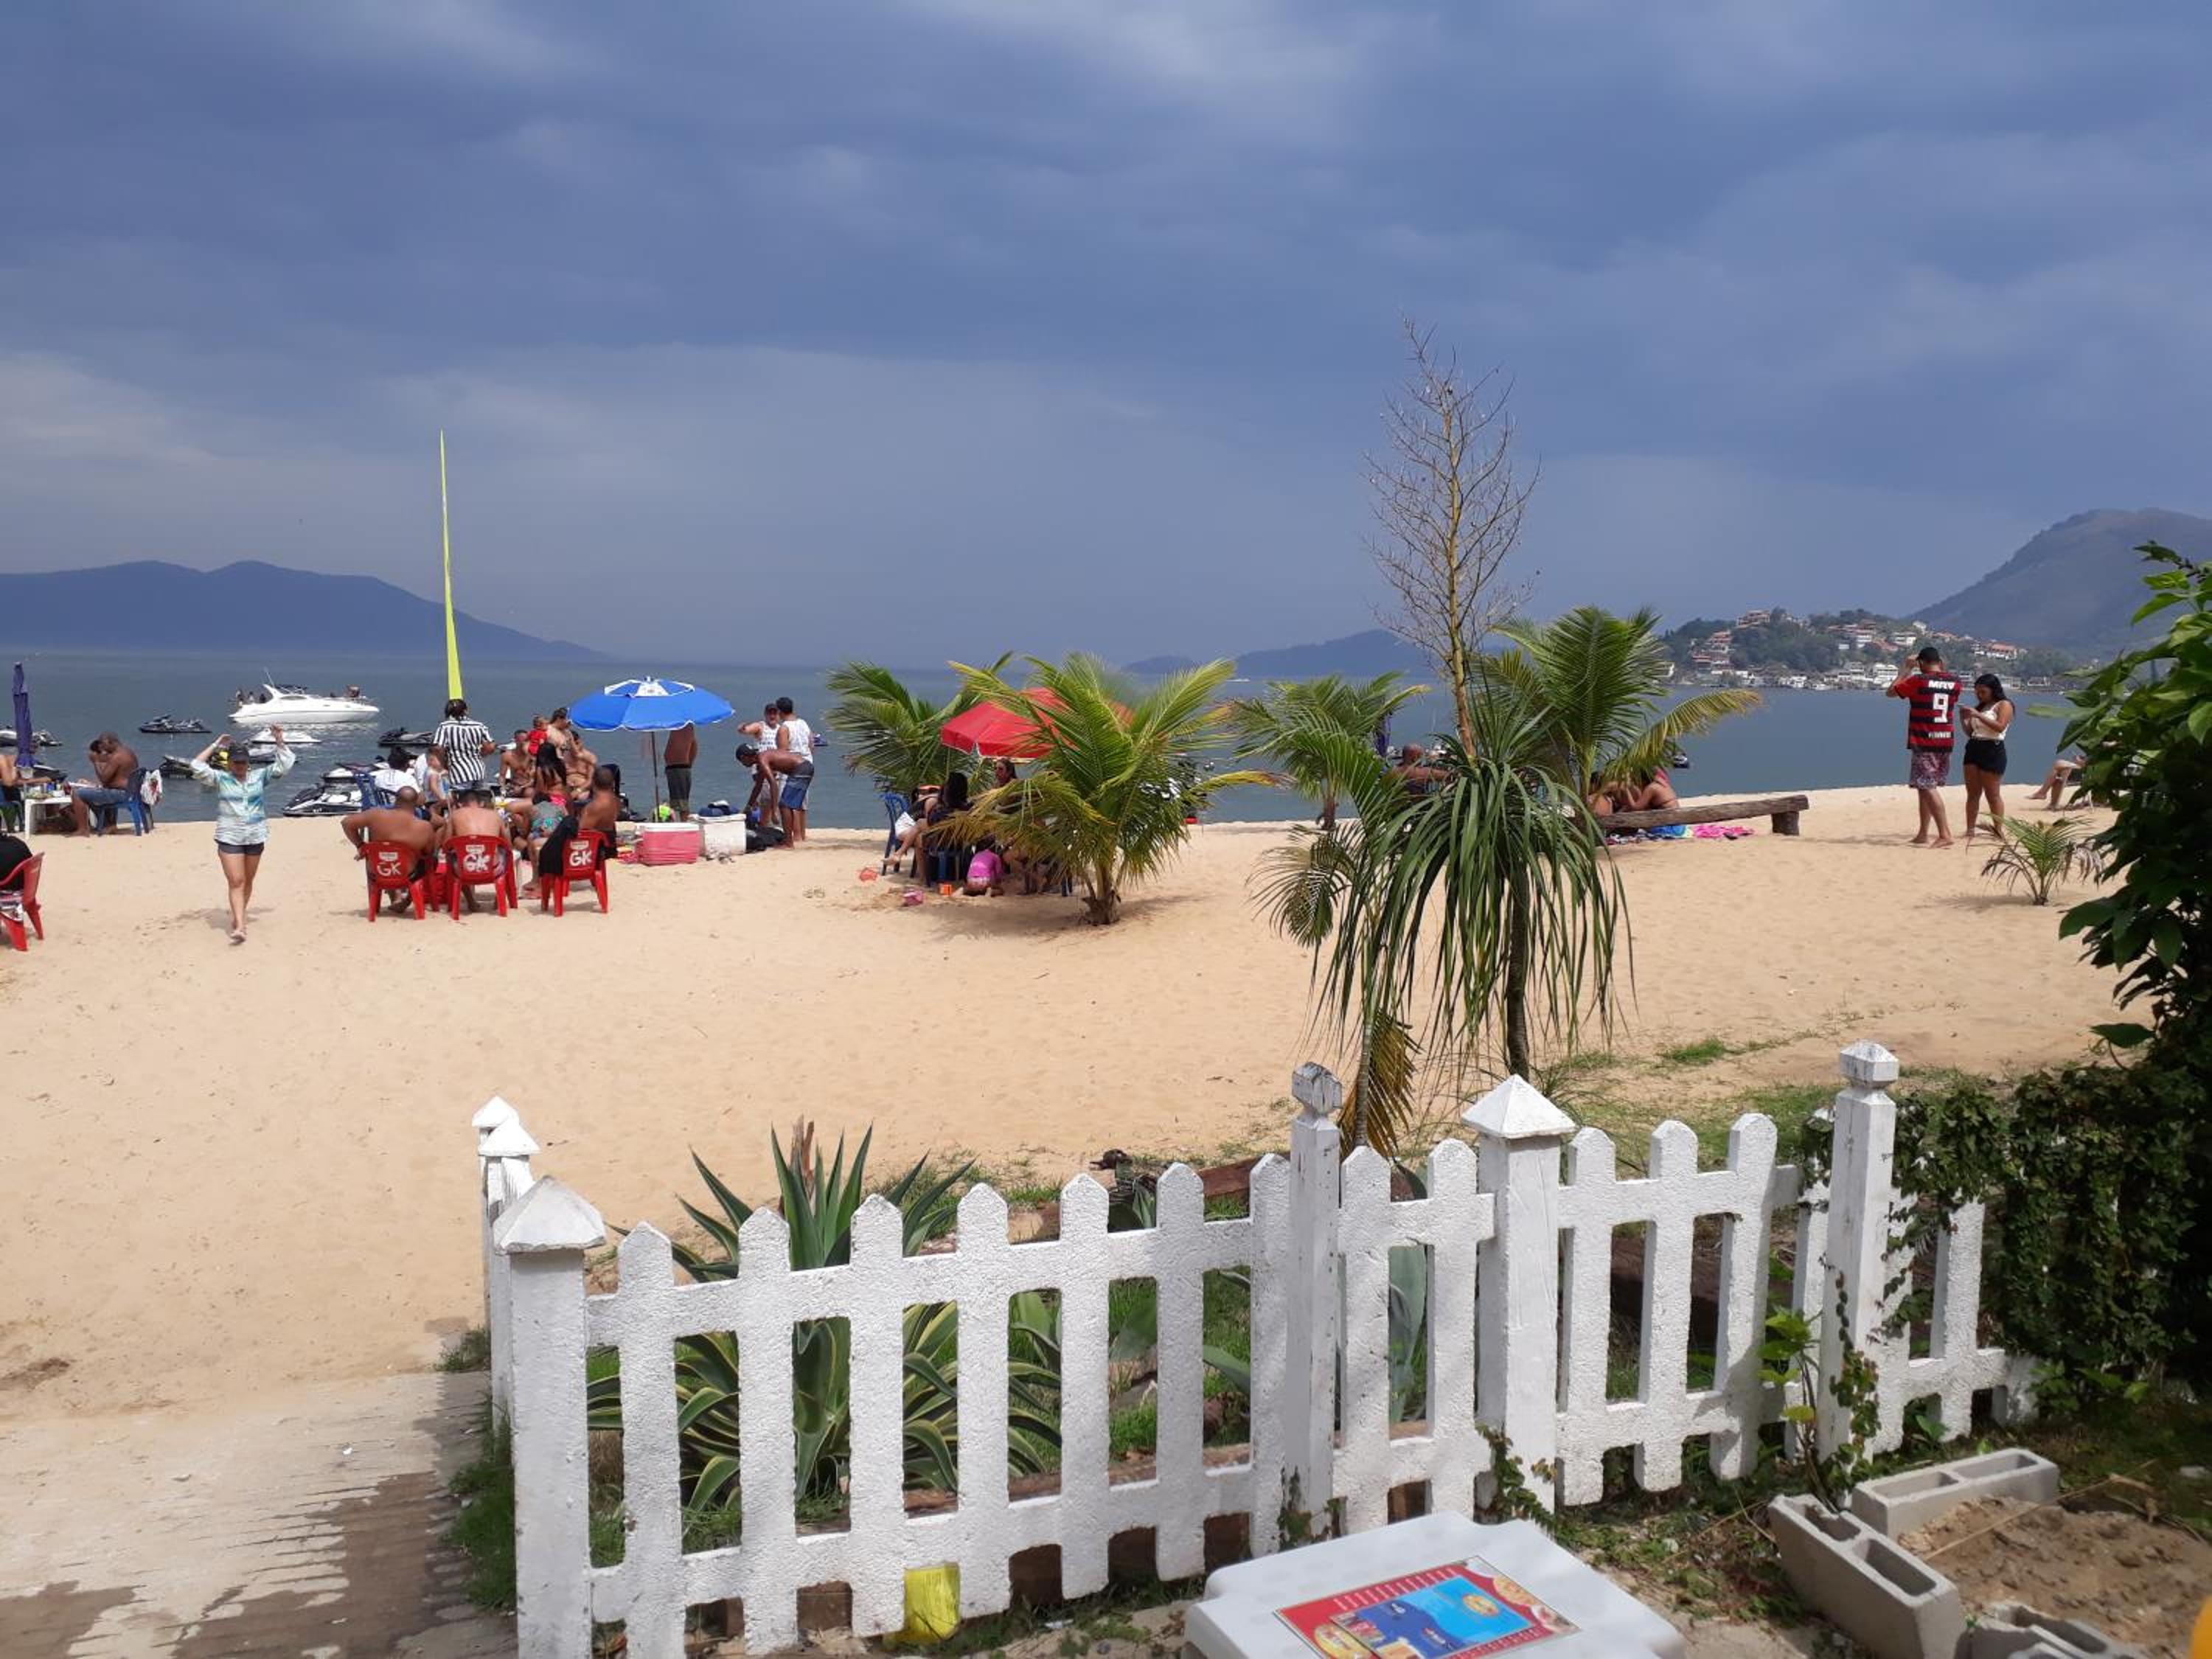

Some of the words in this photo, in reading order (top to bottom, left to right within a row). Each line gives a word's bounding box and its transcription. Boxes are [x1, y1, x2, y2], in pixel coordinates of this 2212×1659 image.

[1933, 693, 1949, 723] 9
[569, 850, 592, 866] GK
[377, 861, 401, 877] GK
